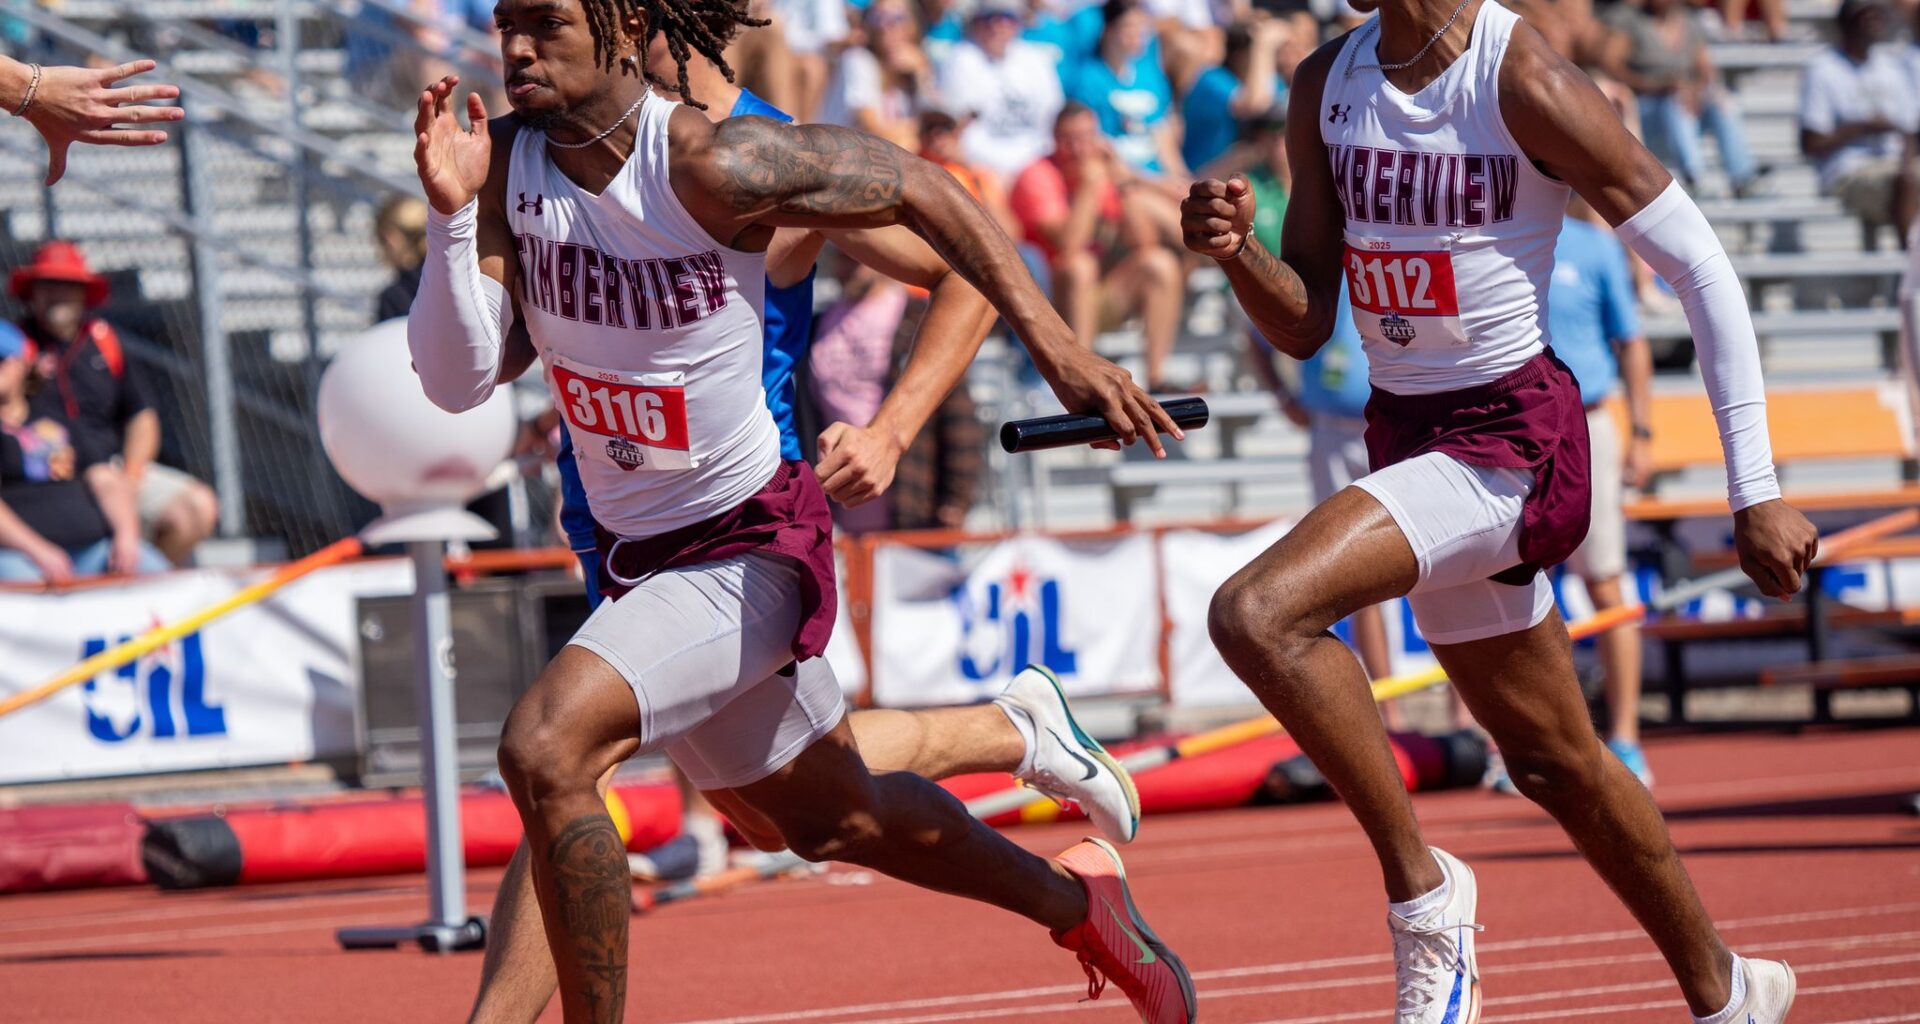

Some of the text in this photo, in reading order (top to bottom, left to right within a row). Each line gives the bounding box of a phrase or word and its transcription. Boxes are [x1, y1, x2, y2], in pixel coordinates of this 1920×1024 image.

[1369, 241, 1391, 250] 2025
[1351, 253, 1437, 309] 3112
[1380, 325, 1415, 336] STATE
[598, 371, 620, 382] 2025
[567, 378, 667, 442] 3116
[606, 446, 644, 464] STATE
[84, 629, 227, 742] UIL
